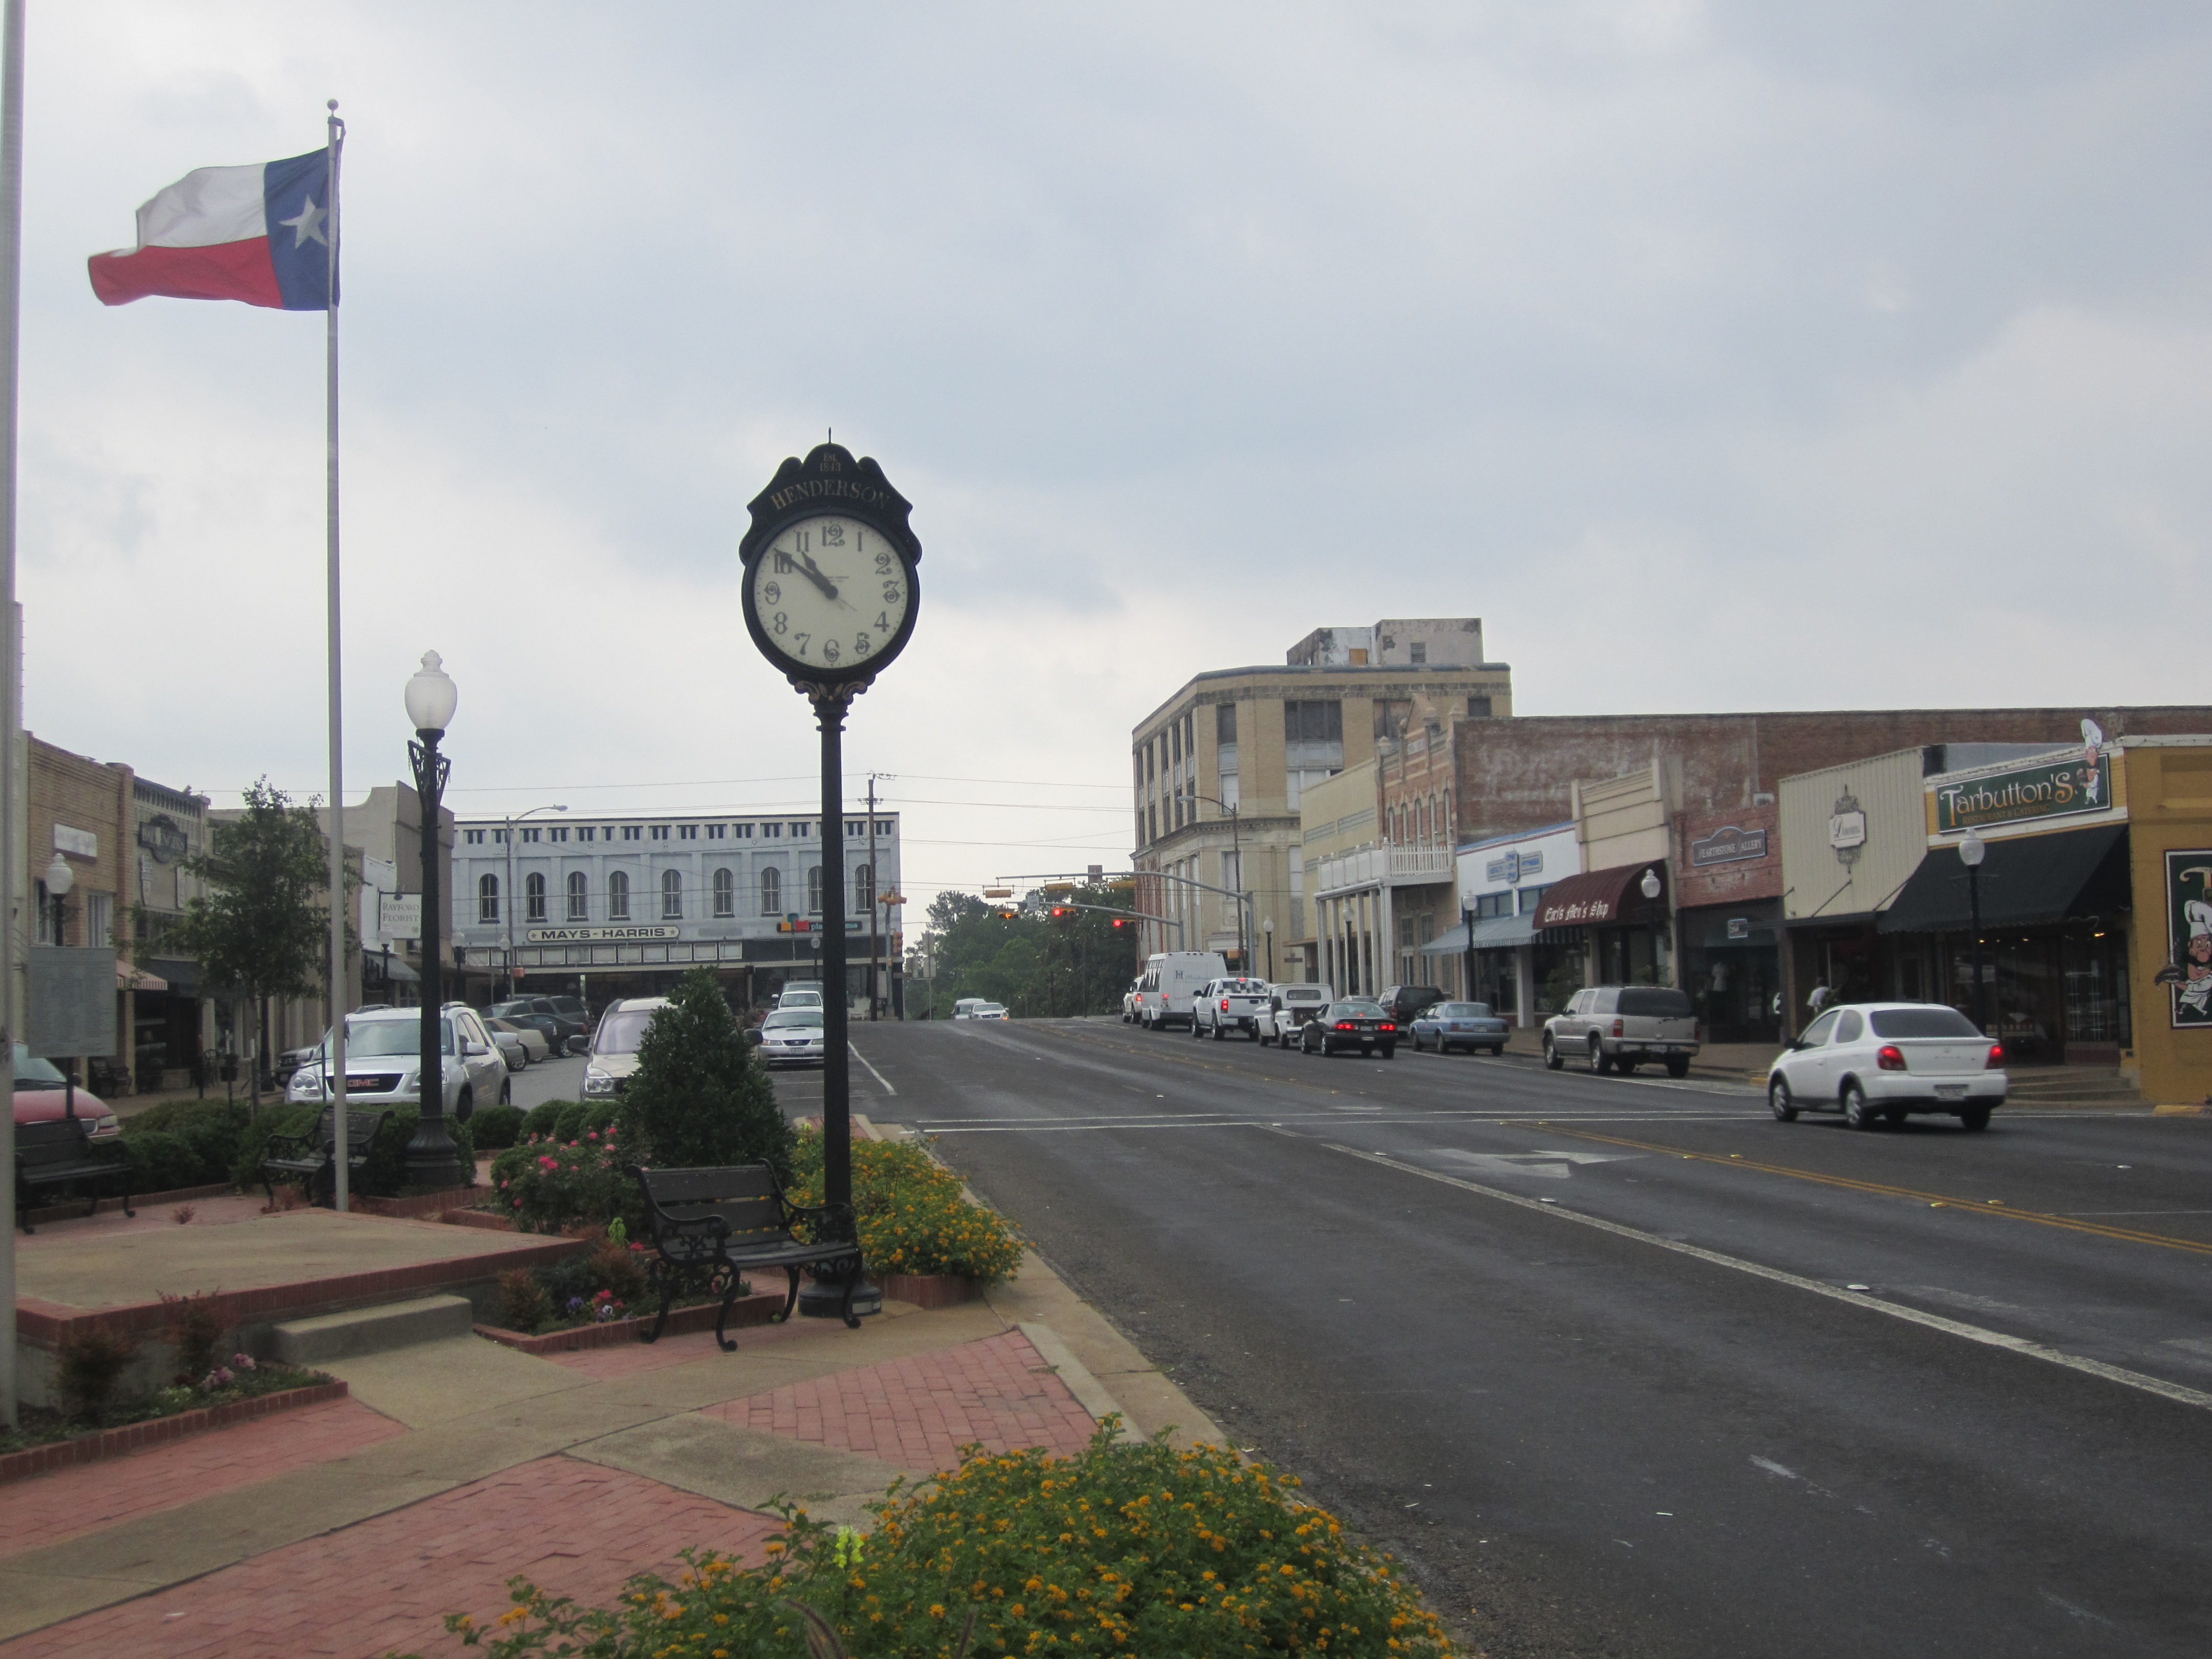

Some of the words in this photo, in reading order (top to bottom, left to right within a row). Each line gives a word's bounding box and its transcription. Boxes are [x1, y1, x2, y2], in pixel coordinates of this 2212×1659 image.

[771, 480, 890, 509] HENDERSON
[796, 531, 810, 552] 11
[822, 524, 845, 546] 12
[857, 531, 862, 552] 1
[875, 552, 892, 575] 2
[764, 581, 781, 605] 9
[883, 580, 900, 603] 3
[773, 612, 788, 634] 8
[874, 611, 890, 632] 4
[795, 633, 811, 655] 7
[824, 639, 840, 662] 6
[854, 632, 870, 654] 5
[1963, 811, 2006, 824] RESTAURANT
[2014, 804, 2050, 816] CATERING
[383, 903, 419, 911] RAYFORD
[383, 913, 418, 922] FLORIST
[348, 1078, 379, 1087] GMC
